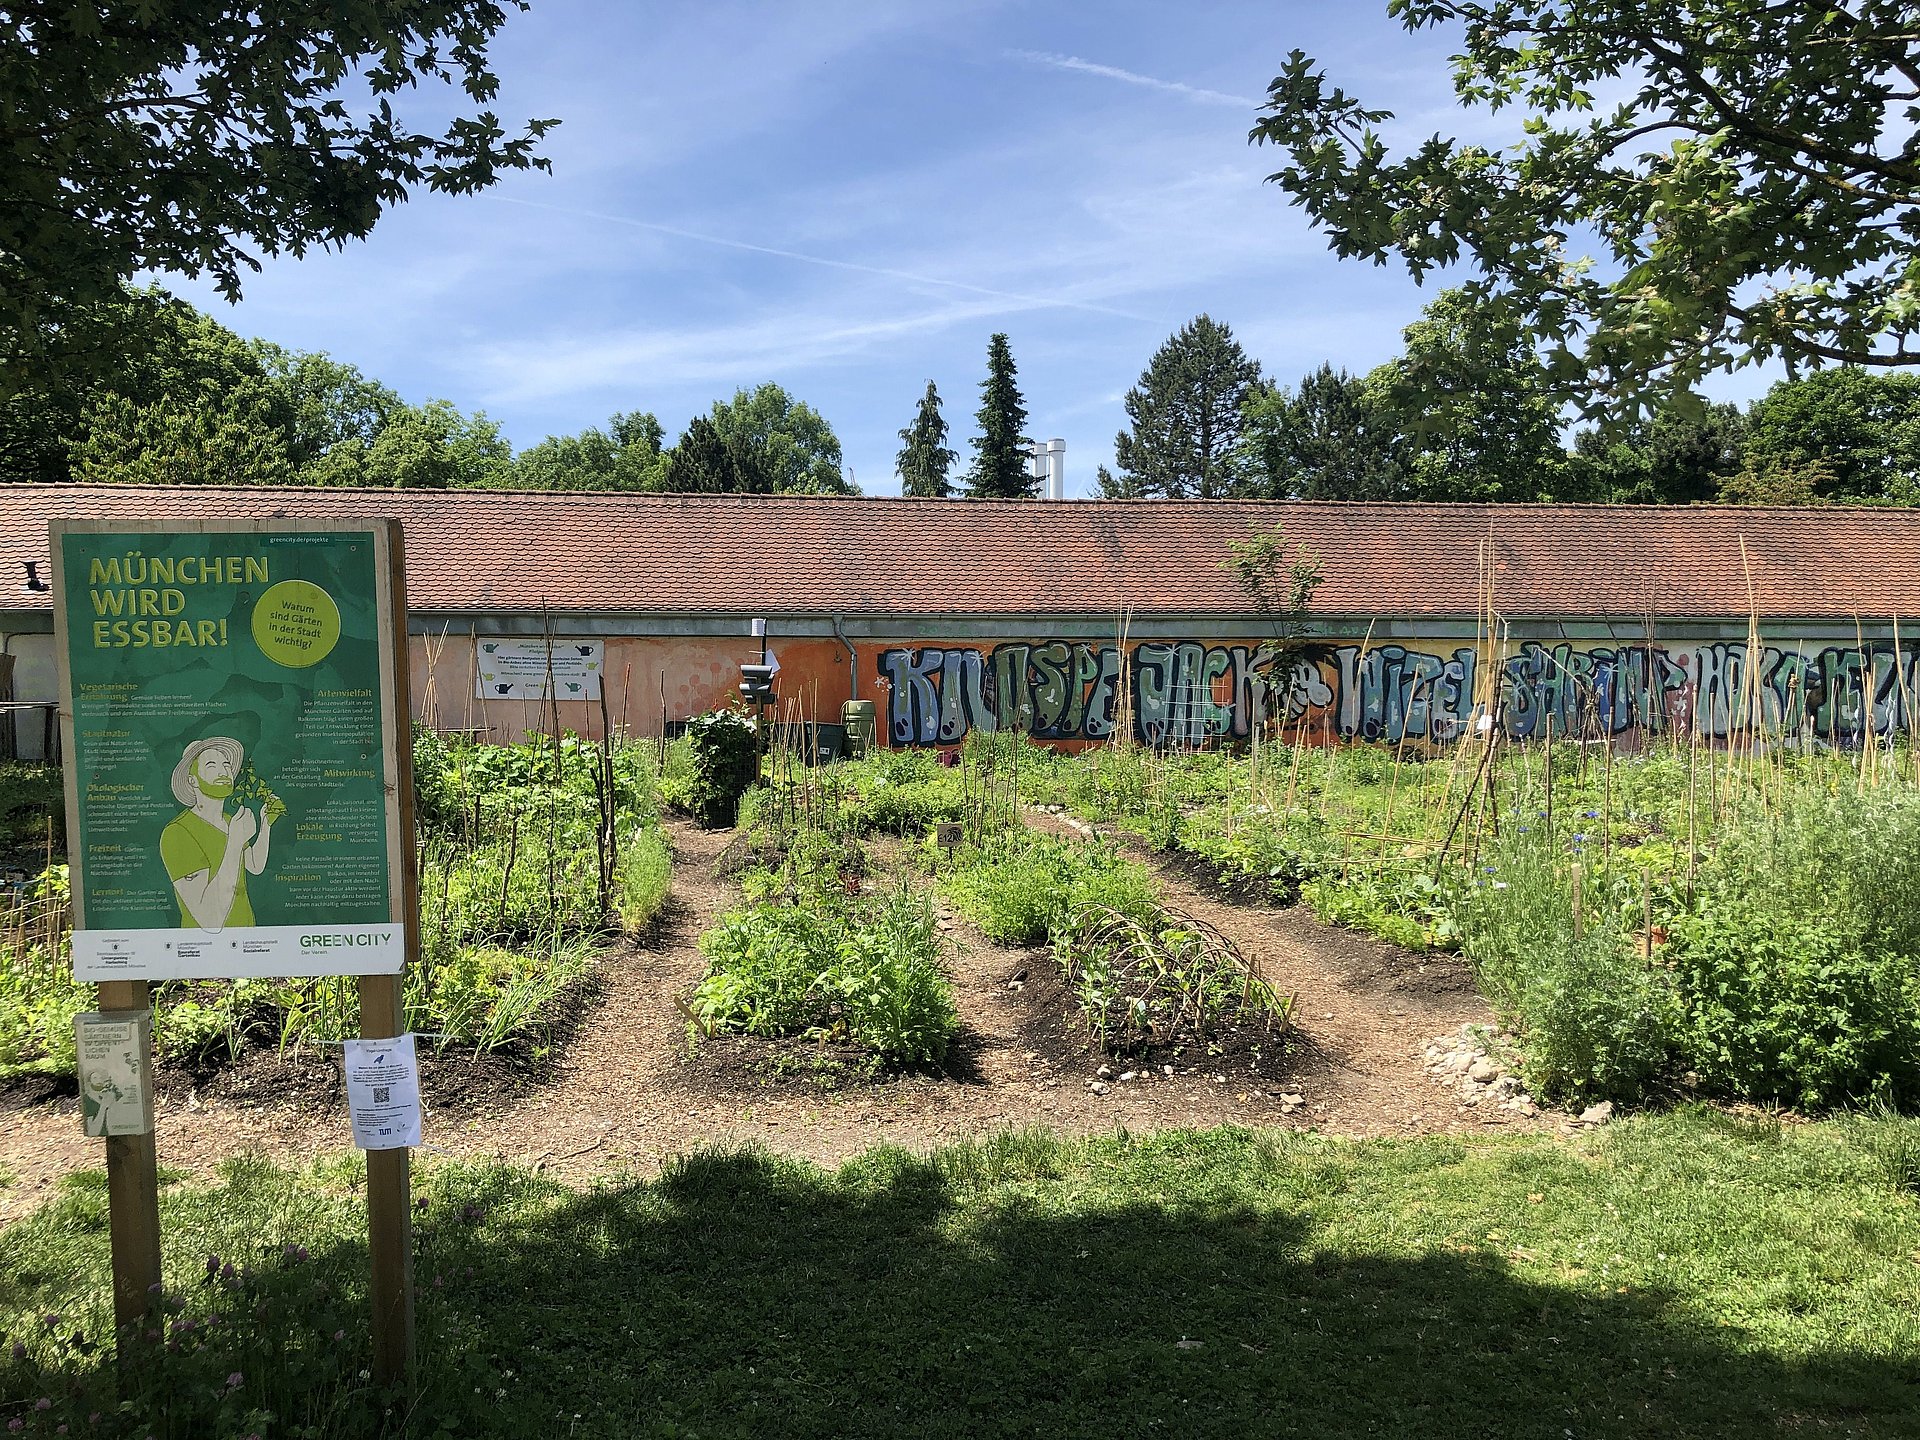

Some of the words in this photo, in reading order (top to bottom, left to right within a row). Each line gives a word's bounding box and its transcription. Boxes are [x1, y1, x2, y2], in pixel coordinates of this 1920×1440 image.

[89, 551, 269, 584] MÜNCHEN
[90, 589, 186, 616] WIRD
[281, 600, 314, 614] Warum
[270, 611, 289, 622] sind
[292, 614, 323, 627] Gärten
[94, 619, 228, 647] ESSBAR!
[269, 623, 278, 632] in
[280, 624, 295, 635] der
[297, 628, 322, 639] Stadt
[274, 636, 312, 649] wichtig?
[318, 689, 372, 697] Artenvielfalt
[324, 769, 376, 778] Mitwirkung
[87, 784, 145, 793] Ökologischer
[296, 832, 342, 841] Erzeugung
[89, 844, 122, 852] Freizeit
[276, 873, 321, 882] Inspiration
[300, 935, 353, 947] GREEN
[357, 933, 391, 946] CITY
